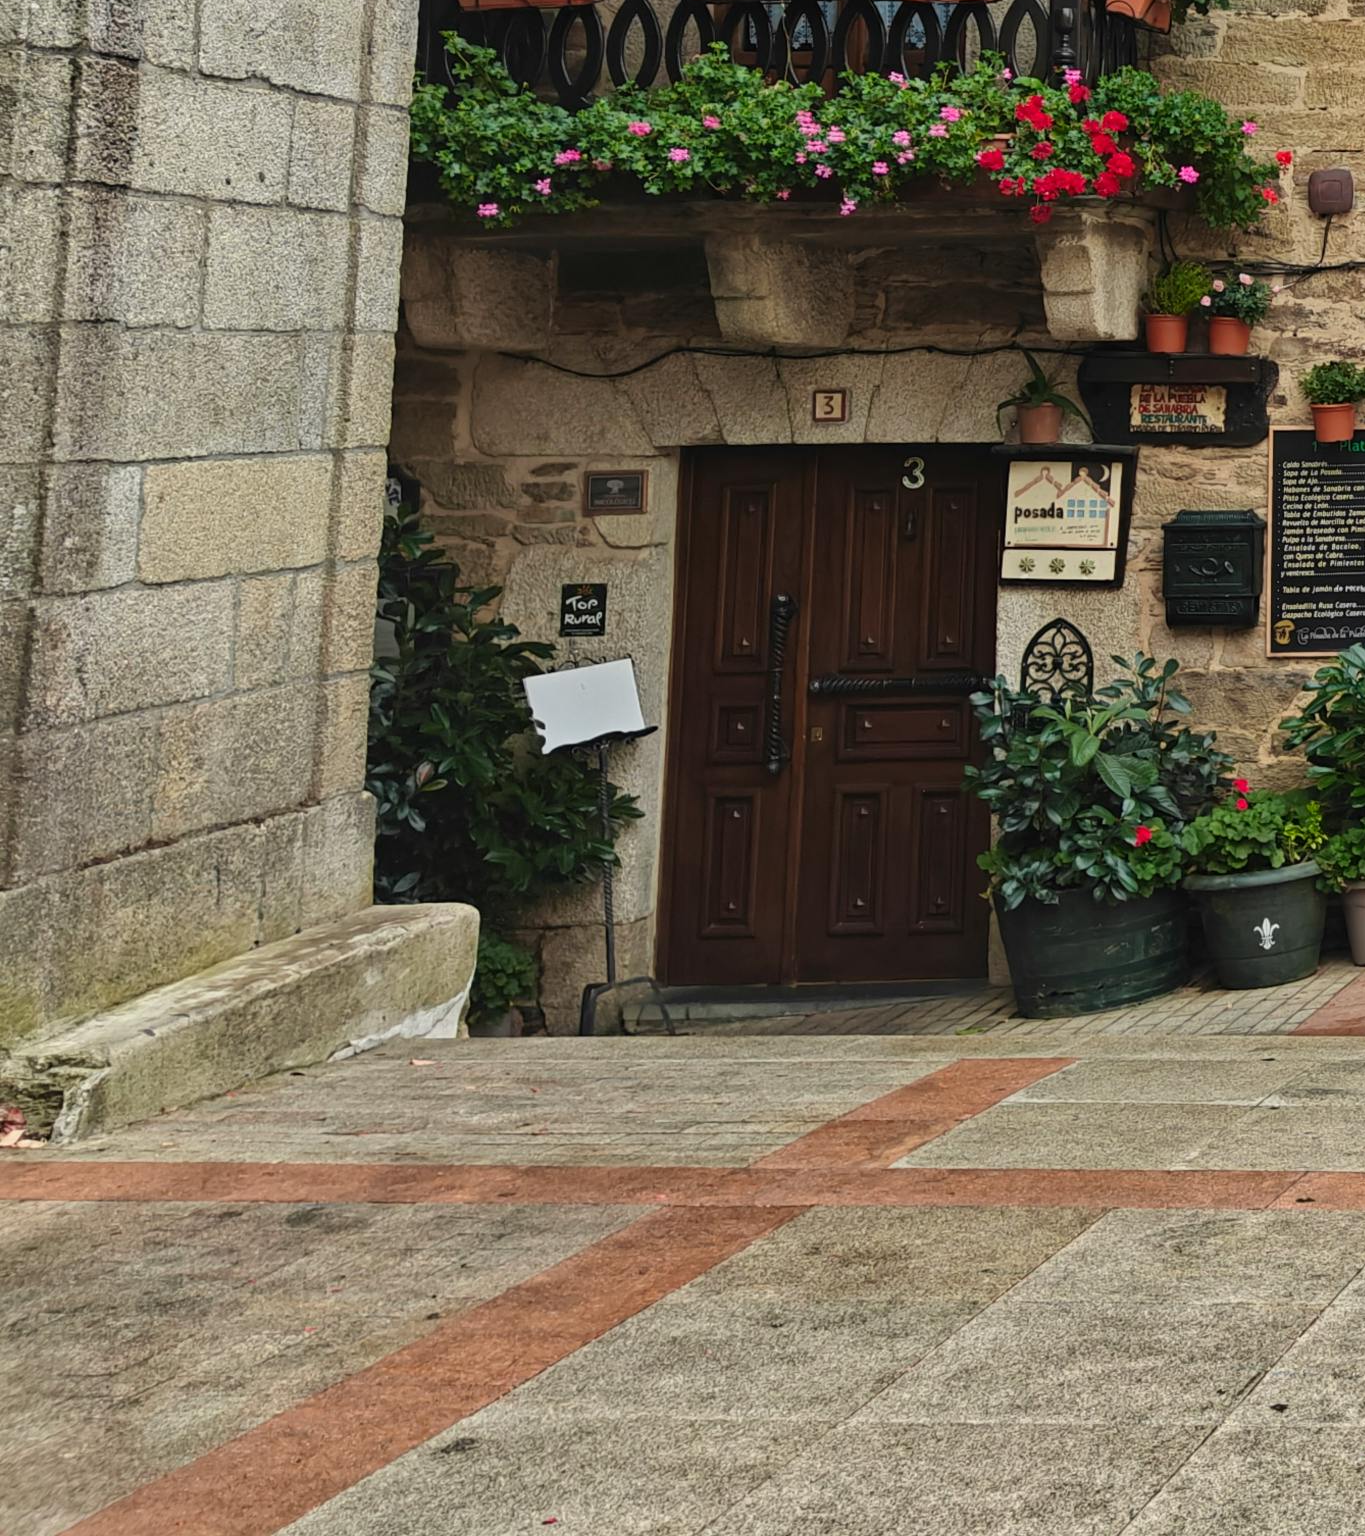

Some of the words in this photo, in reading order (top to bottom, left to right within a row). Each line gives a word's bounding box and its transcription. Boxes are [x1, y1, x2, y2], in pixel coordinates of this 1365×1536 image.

[1154, 394, 1165, 403] LA
[1168, 394, 1206, 403] PUEBLA
[824, 396, 833, 415] 3
[1138, 405, 1151, 413] DE
[1153, 404, 1198, 413] SANABRIA
[1141, 415, 1208, 424] RESTAURANTE
[902, 457, 924, 488] 3
[1015, 502, 1064, 524] posada
[564, 612, 602, 625] Rural
